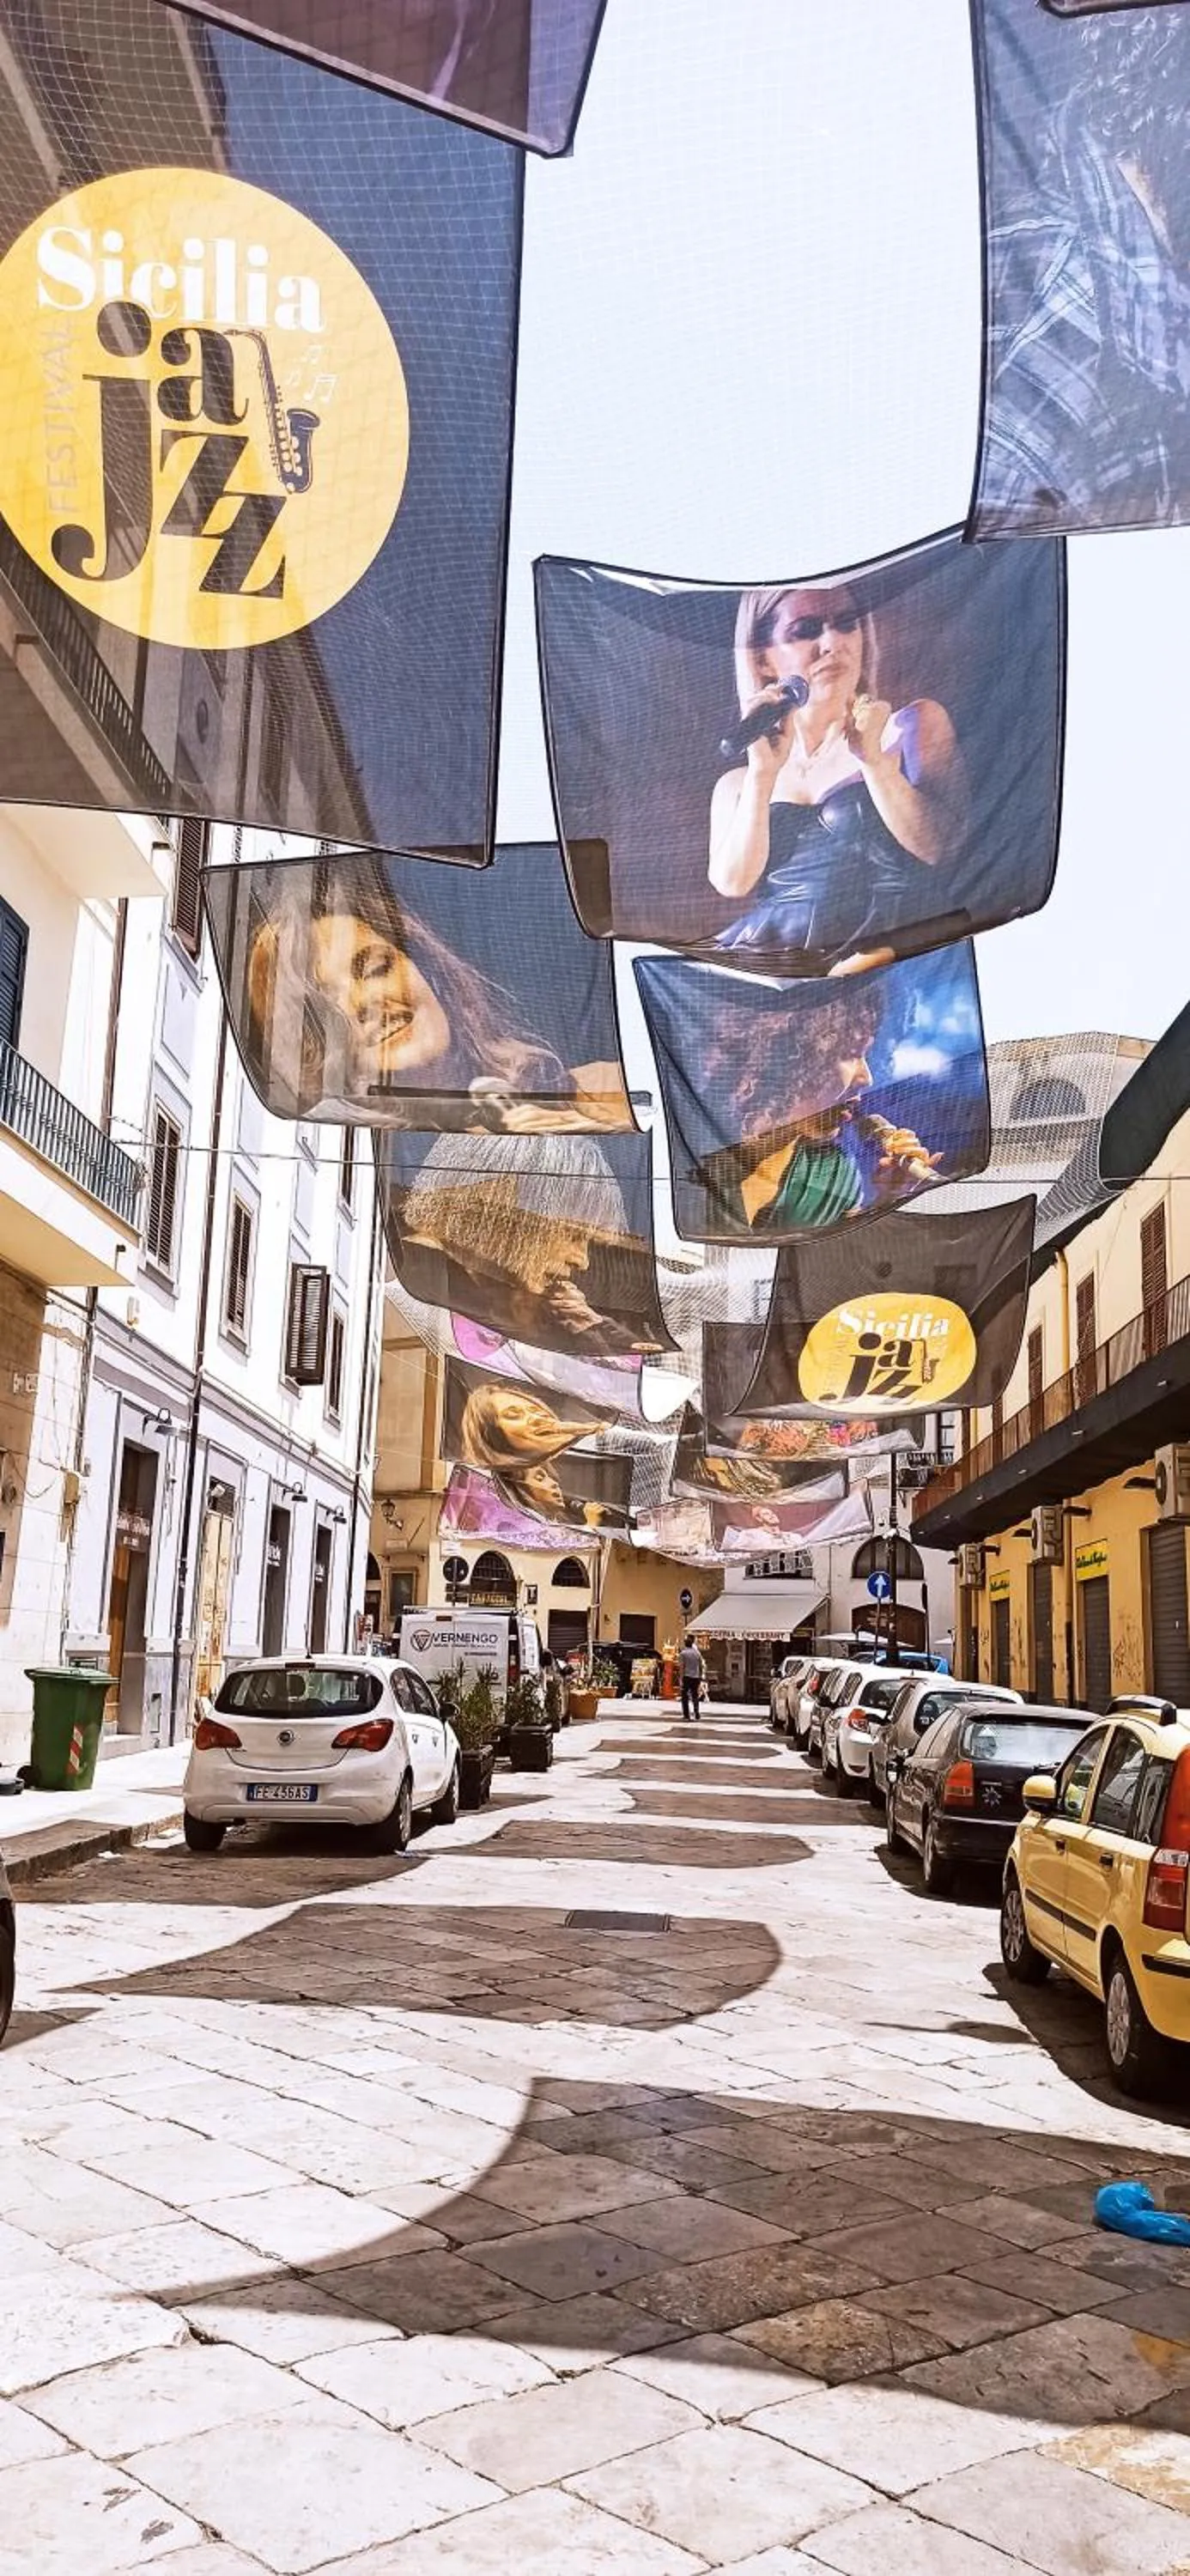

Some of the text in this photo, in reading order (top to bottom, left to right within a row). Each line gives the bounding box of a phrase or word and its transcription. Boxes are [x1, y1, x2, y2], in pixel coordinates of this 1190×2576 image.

[37, 226, 327, 333] Sicilia
[41, 318, 81, 513] FESTIVAL
[51, 301, 288, 599] jazz
[818, 1332, 924, 1405] jazz
[836, 1307, 950, 1340] Sicilia
[432, 1632, 499, 1643] VERNENGO
